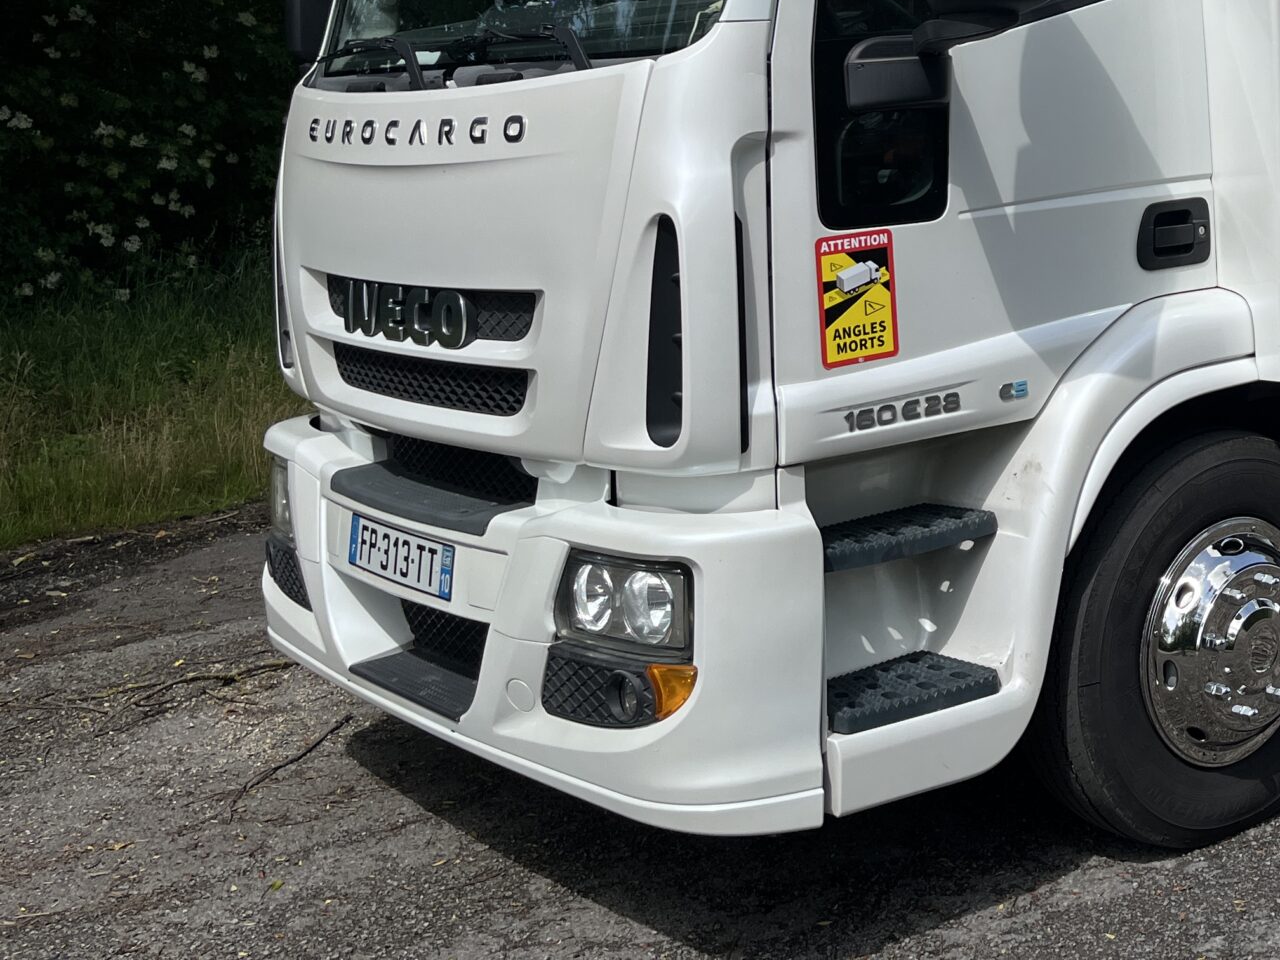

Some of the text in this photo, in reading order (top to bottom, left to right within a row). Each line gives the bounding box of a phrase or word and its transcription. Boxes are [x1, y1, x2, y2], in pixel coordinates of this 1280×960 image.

[309, 115, 527, 146] EUROCARGO
[820, 233, 889, 253] ATTENTION
[344, 280, 475, 349] IVECO
[832, 320, 887, 341] ANGLES
[836, 335, 885, 355] MORTS
[844, 392, 961, 432] 160E28
[359, 524, 438, 587] FP-313-TT
[440, 573, 450, 593] 10
